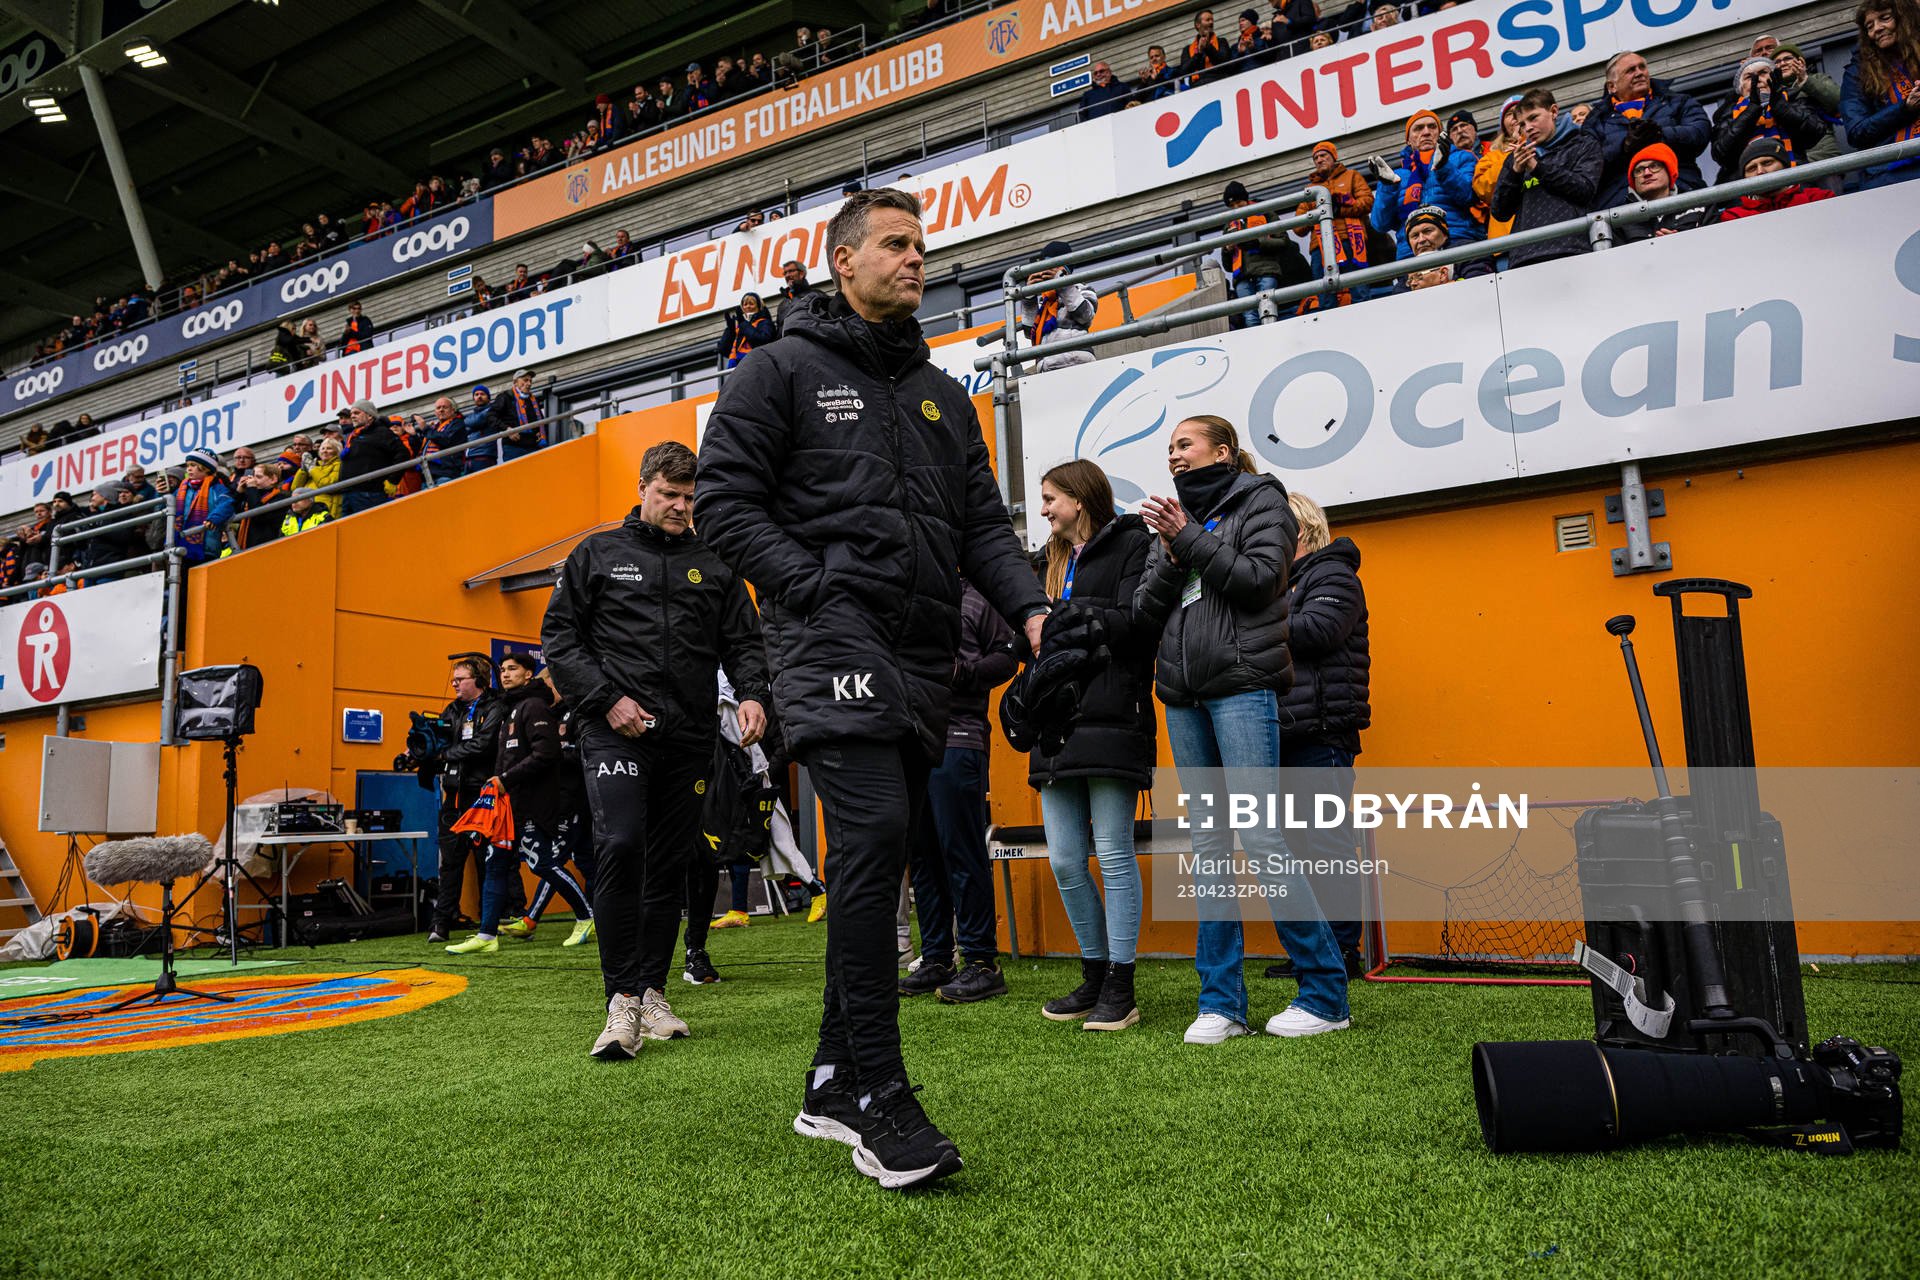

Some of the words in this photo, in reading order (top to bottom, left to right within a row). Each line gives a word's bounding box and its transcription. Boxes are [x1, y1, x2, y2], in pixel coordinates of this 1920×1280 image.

[1236, 0, 1731, 147] INTERSP
[601, 117, 737, 194] AALESUNDS
[743, 42, 944, 145] FOTBALLKLUBB
[392, 216, 470, 263] coop
[281, 260, 349, 303] coop
[182, 300, 243, 339] coop
[94, 334, 149, 371] coop
[320, 297, 573, 414] INTERSPORT
[14, 366, 64, 400] coop
[1247, 298, 1804, 471] Ocean
[816, 399, 853, 408] SpareBank
[839, 412, 859, 420] LNS
[56, 401, 241, 490] INTERSPORT
[832, 673, 875, 701] KK
[597, 760, 639, 778] AAB
[994, 848, 1024, 858] SIMEK
[1808, 1132, 1841, 1143] Nikon
